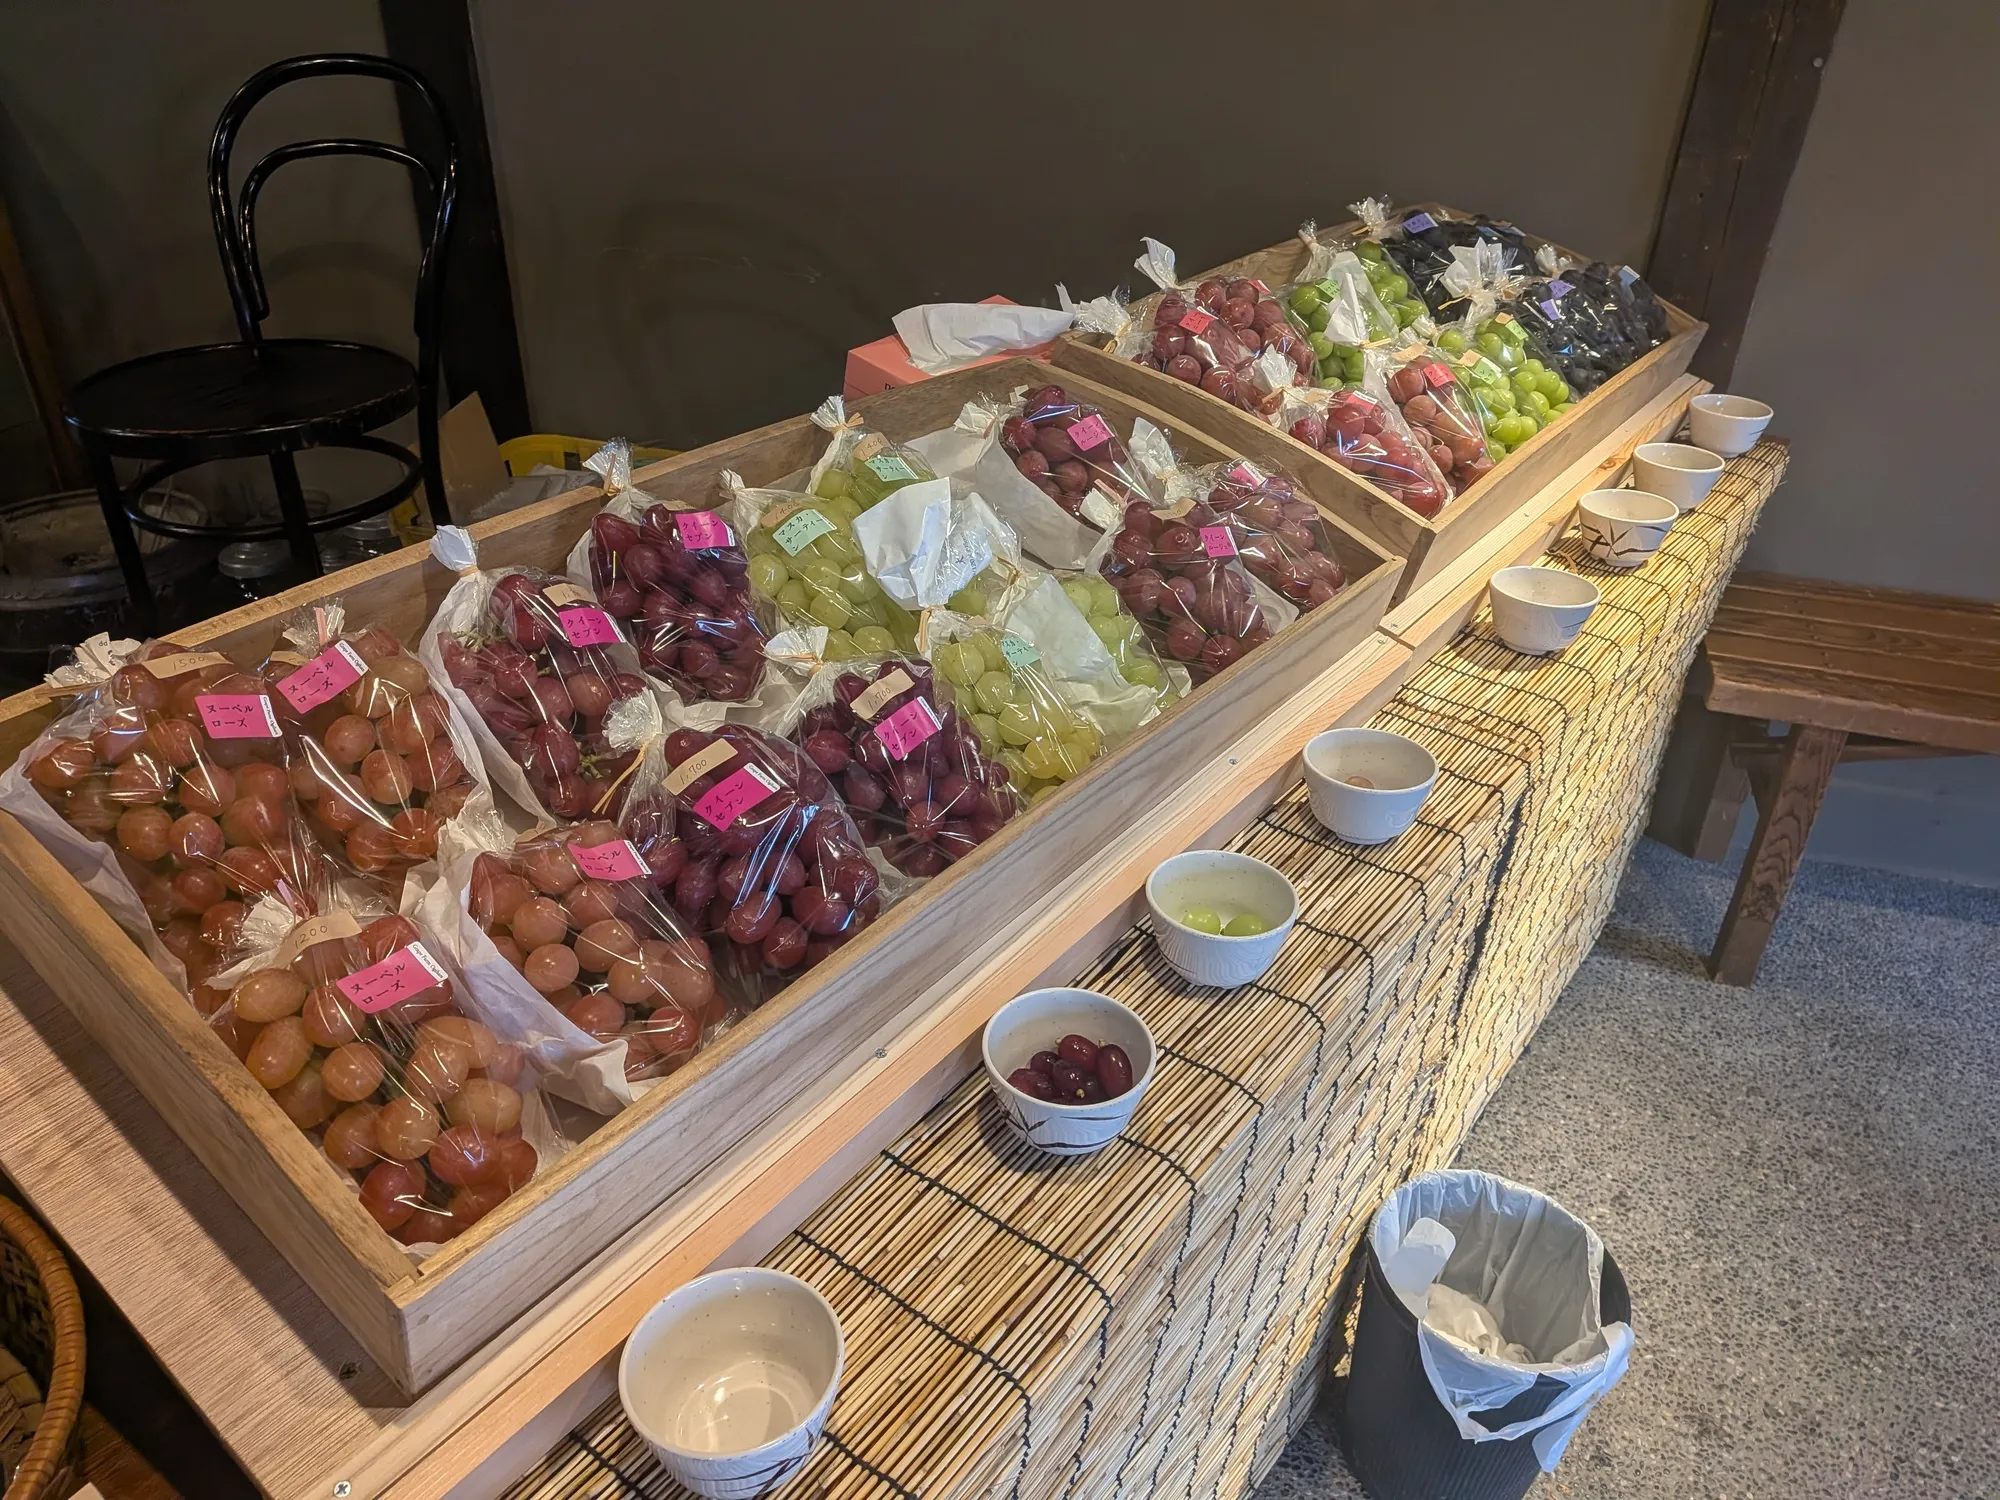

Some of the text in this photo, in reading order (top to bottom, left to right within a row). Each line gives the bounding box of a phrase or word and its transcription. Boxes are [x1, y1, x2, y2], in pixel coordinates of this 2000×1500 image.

[682, 520, 719, 531] クイーン
[567, 615, 602, 628] クイーン
[572, 628, 601, 639] セブン
[288, 660, 334, 695] ヌーベル
[297, 677, 334, 703] ローズ
[206, 703, 254, 714] ヌーベル
[211, 717, 248, 728] ローズ
[705, 781, 744, 817] クイーン
[715, 798, 744, 822] セブン
[294, 924, 328, 949] 1200
[411, 943, 424, 956] Grape
[421, 954, 432, 965] Farm
[350, 962, 406, 996] ヌーベル
[362, 979, 406, 1005] ローズ
